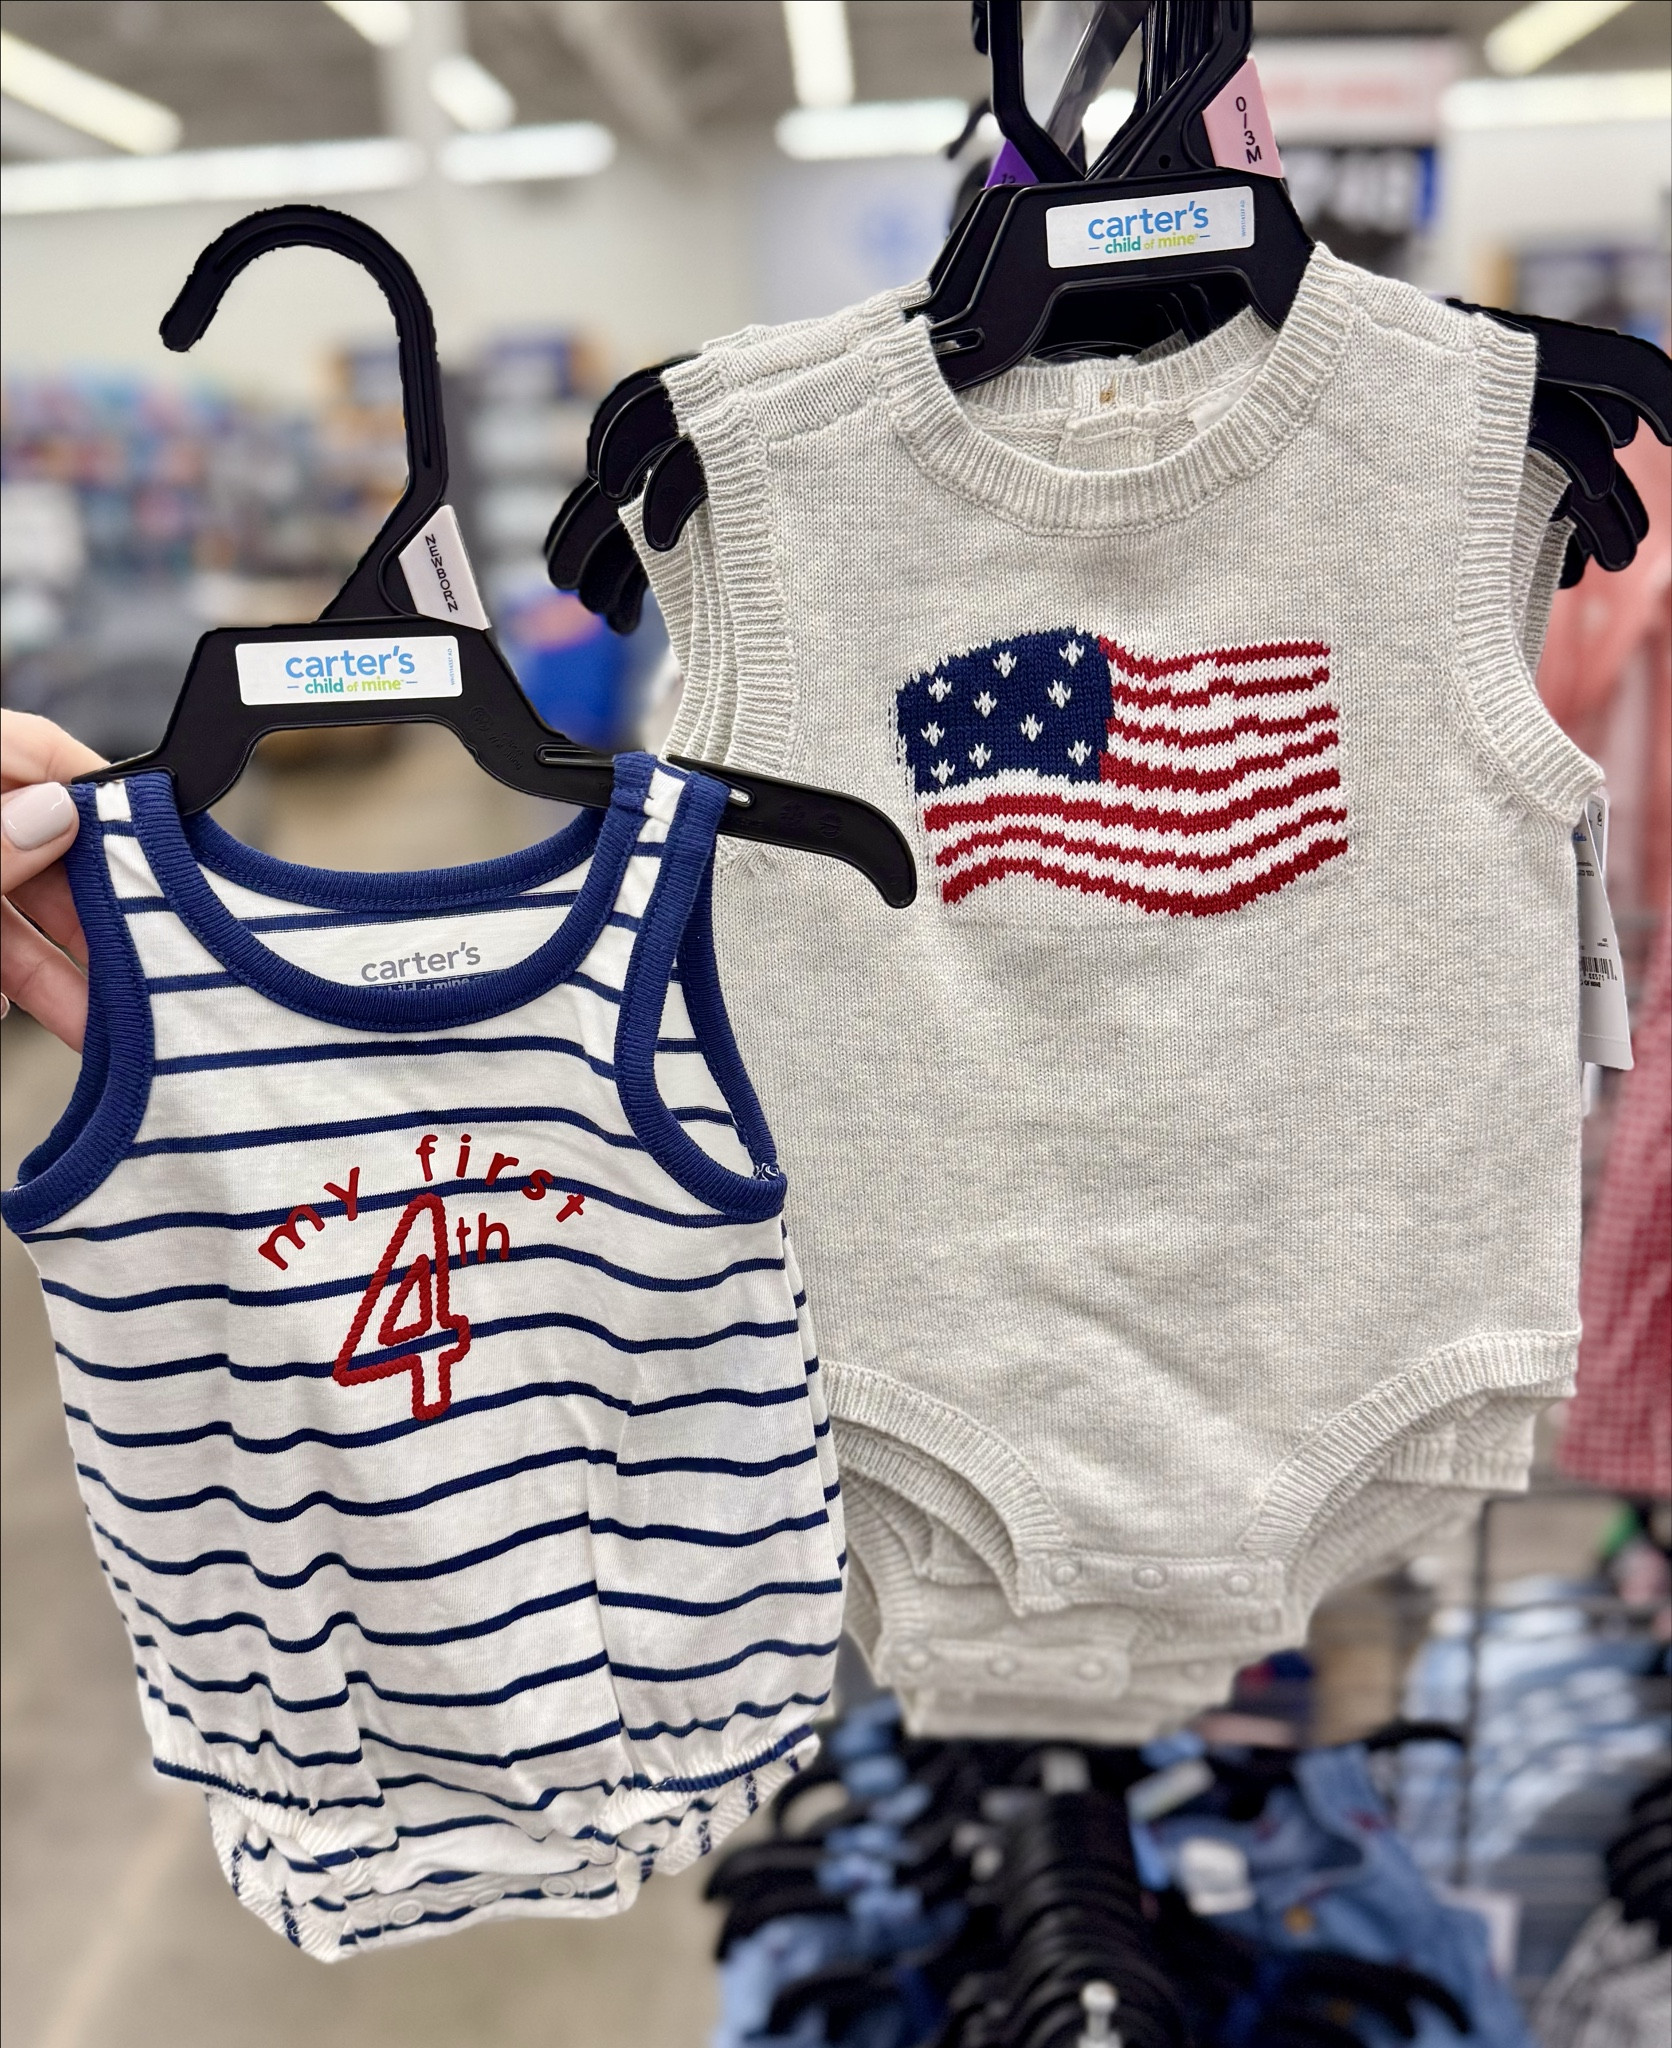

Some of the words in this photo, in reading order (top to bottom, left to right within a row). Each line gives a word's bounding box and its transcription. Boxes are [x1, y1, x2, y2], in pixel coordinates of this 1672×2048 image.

[1088, 200, 1209, 240] carter's
[1105, 235, 1141, 254] child
[1144, 241, 1154, 251] of
[1157, 232, 1196, 248] mine
[424, 533, 458, 612] NEWBORN
[285, 645, 415, 678] carter's
[304, 677, 344, 694] child
[347, 681, 358, 692] of
[361, 676, 402, 691] mine
[361, 941, 481, 982] carter's
[258, 1166, 361, 1270] my
[415, 1133, 585, 1222] first
